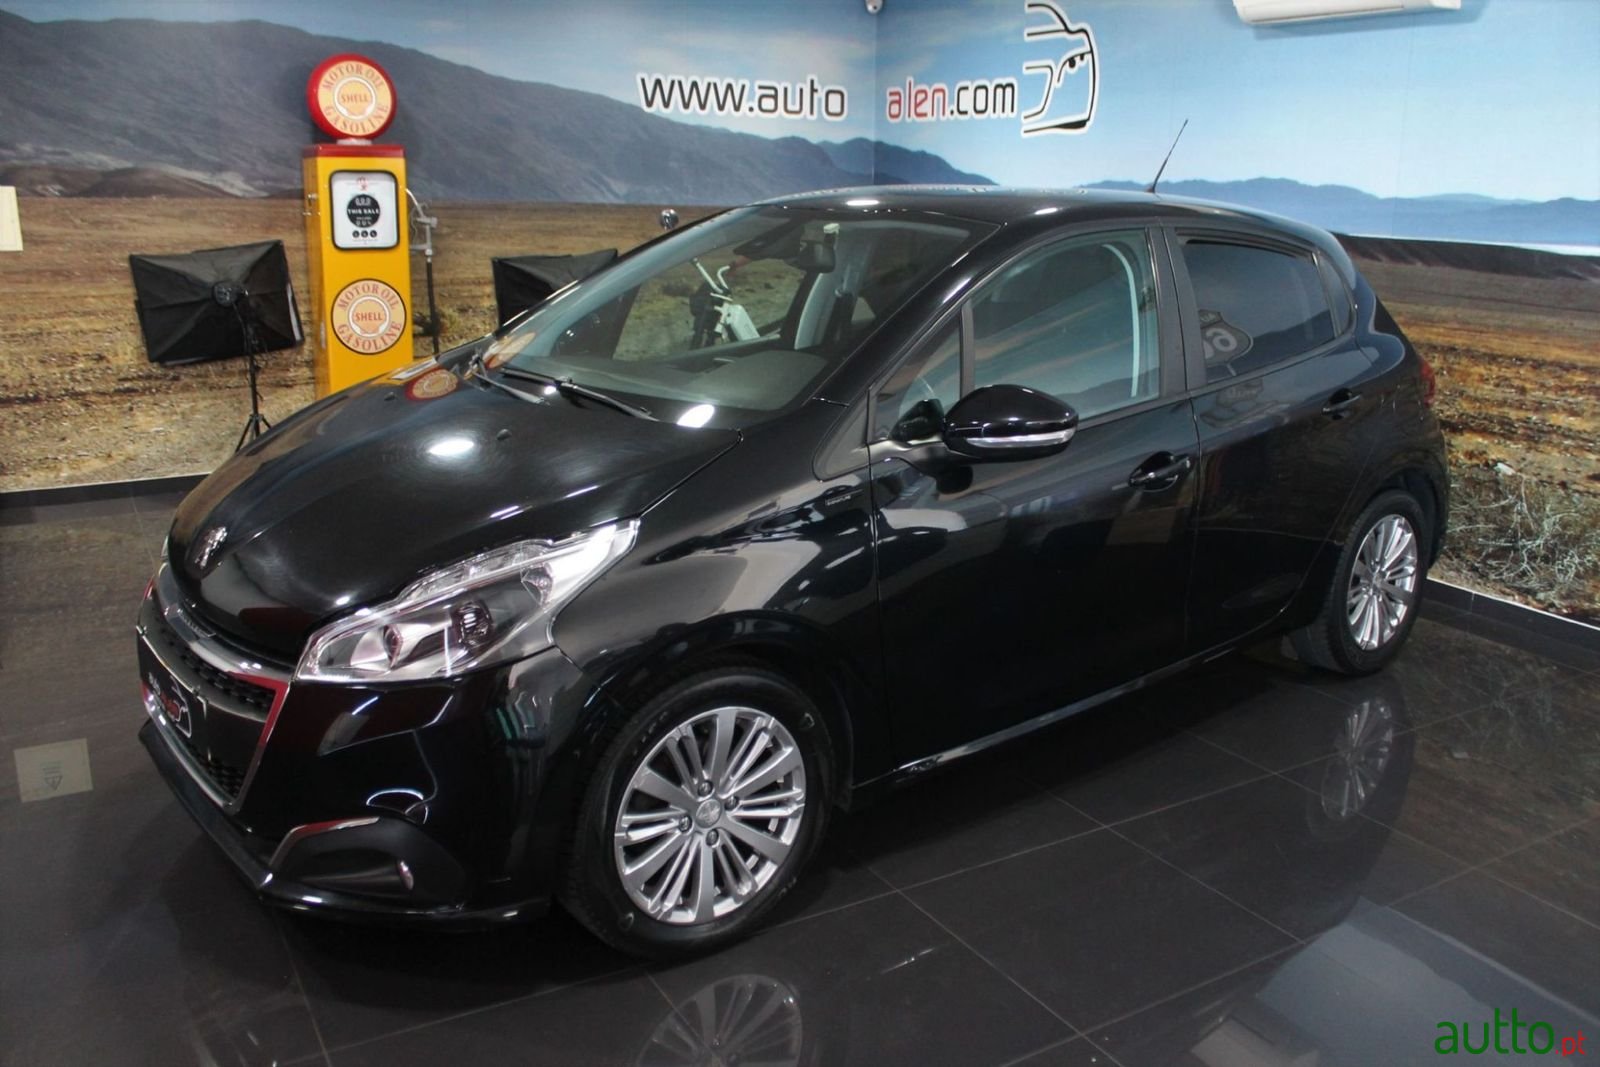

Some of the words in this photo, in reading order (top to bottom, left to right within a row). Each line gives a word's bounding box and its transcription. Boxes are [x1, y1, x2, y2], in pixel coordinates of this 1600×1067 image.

[322, 63, 363, 90] MOTOR
[365, 68, 384, 90] OIL
[341, 93, 369, 104] SHELL
[640, 77, 845, 117] www.auto
[888, 80, 1015, 119] alen.com
[324, 103, 389, 133] GASOLINE
[337, 283, 379, 311] MOTOR
[381, 287, 399, 310] OIL
[355, 312, 383, 322] SHELL
[338, 321, 402, 351] GASOLINE
